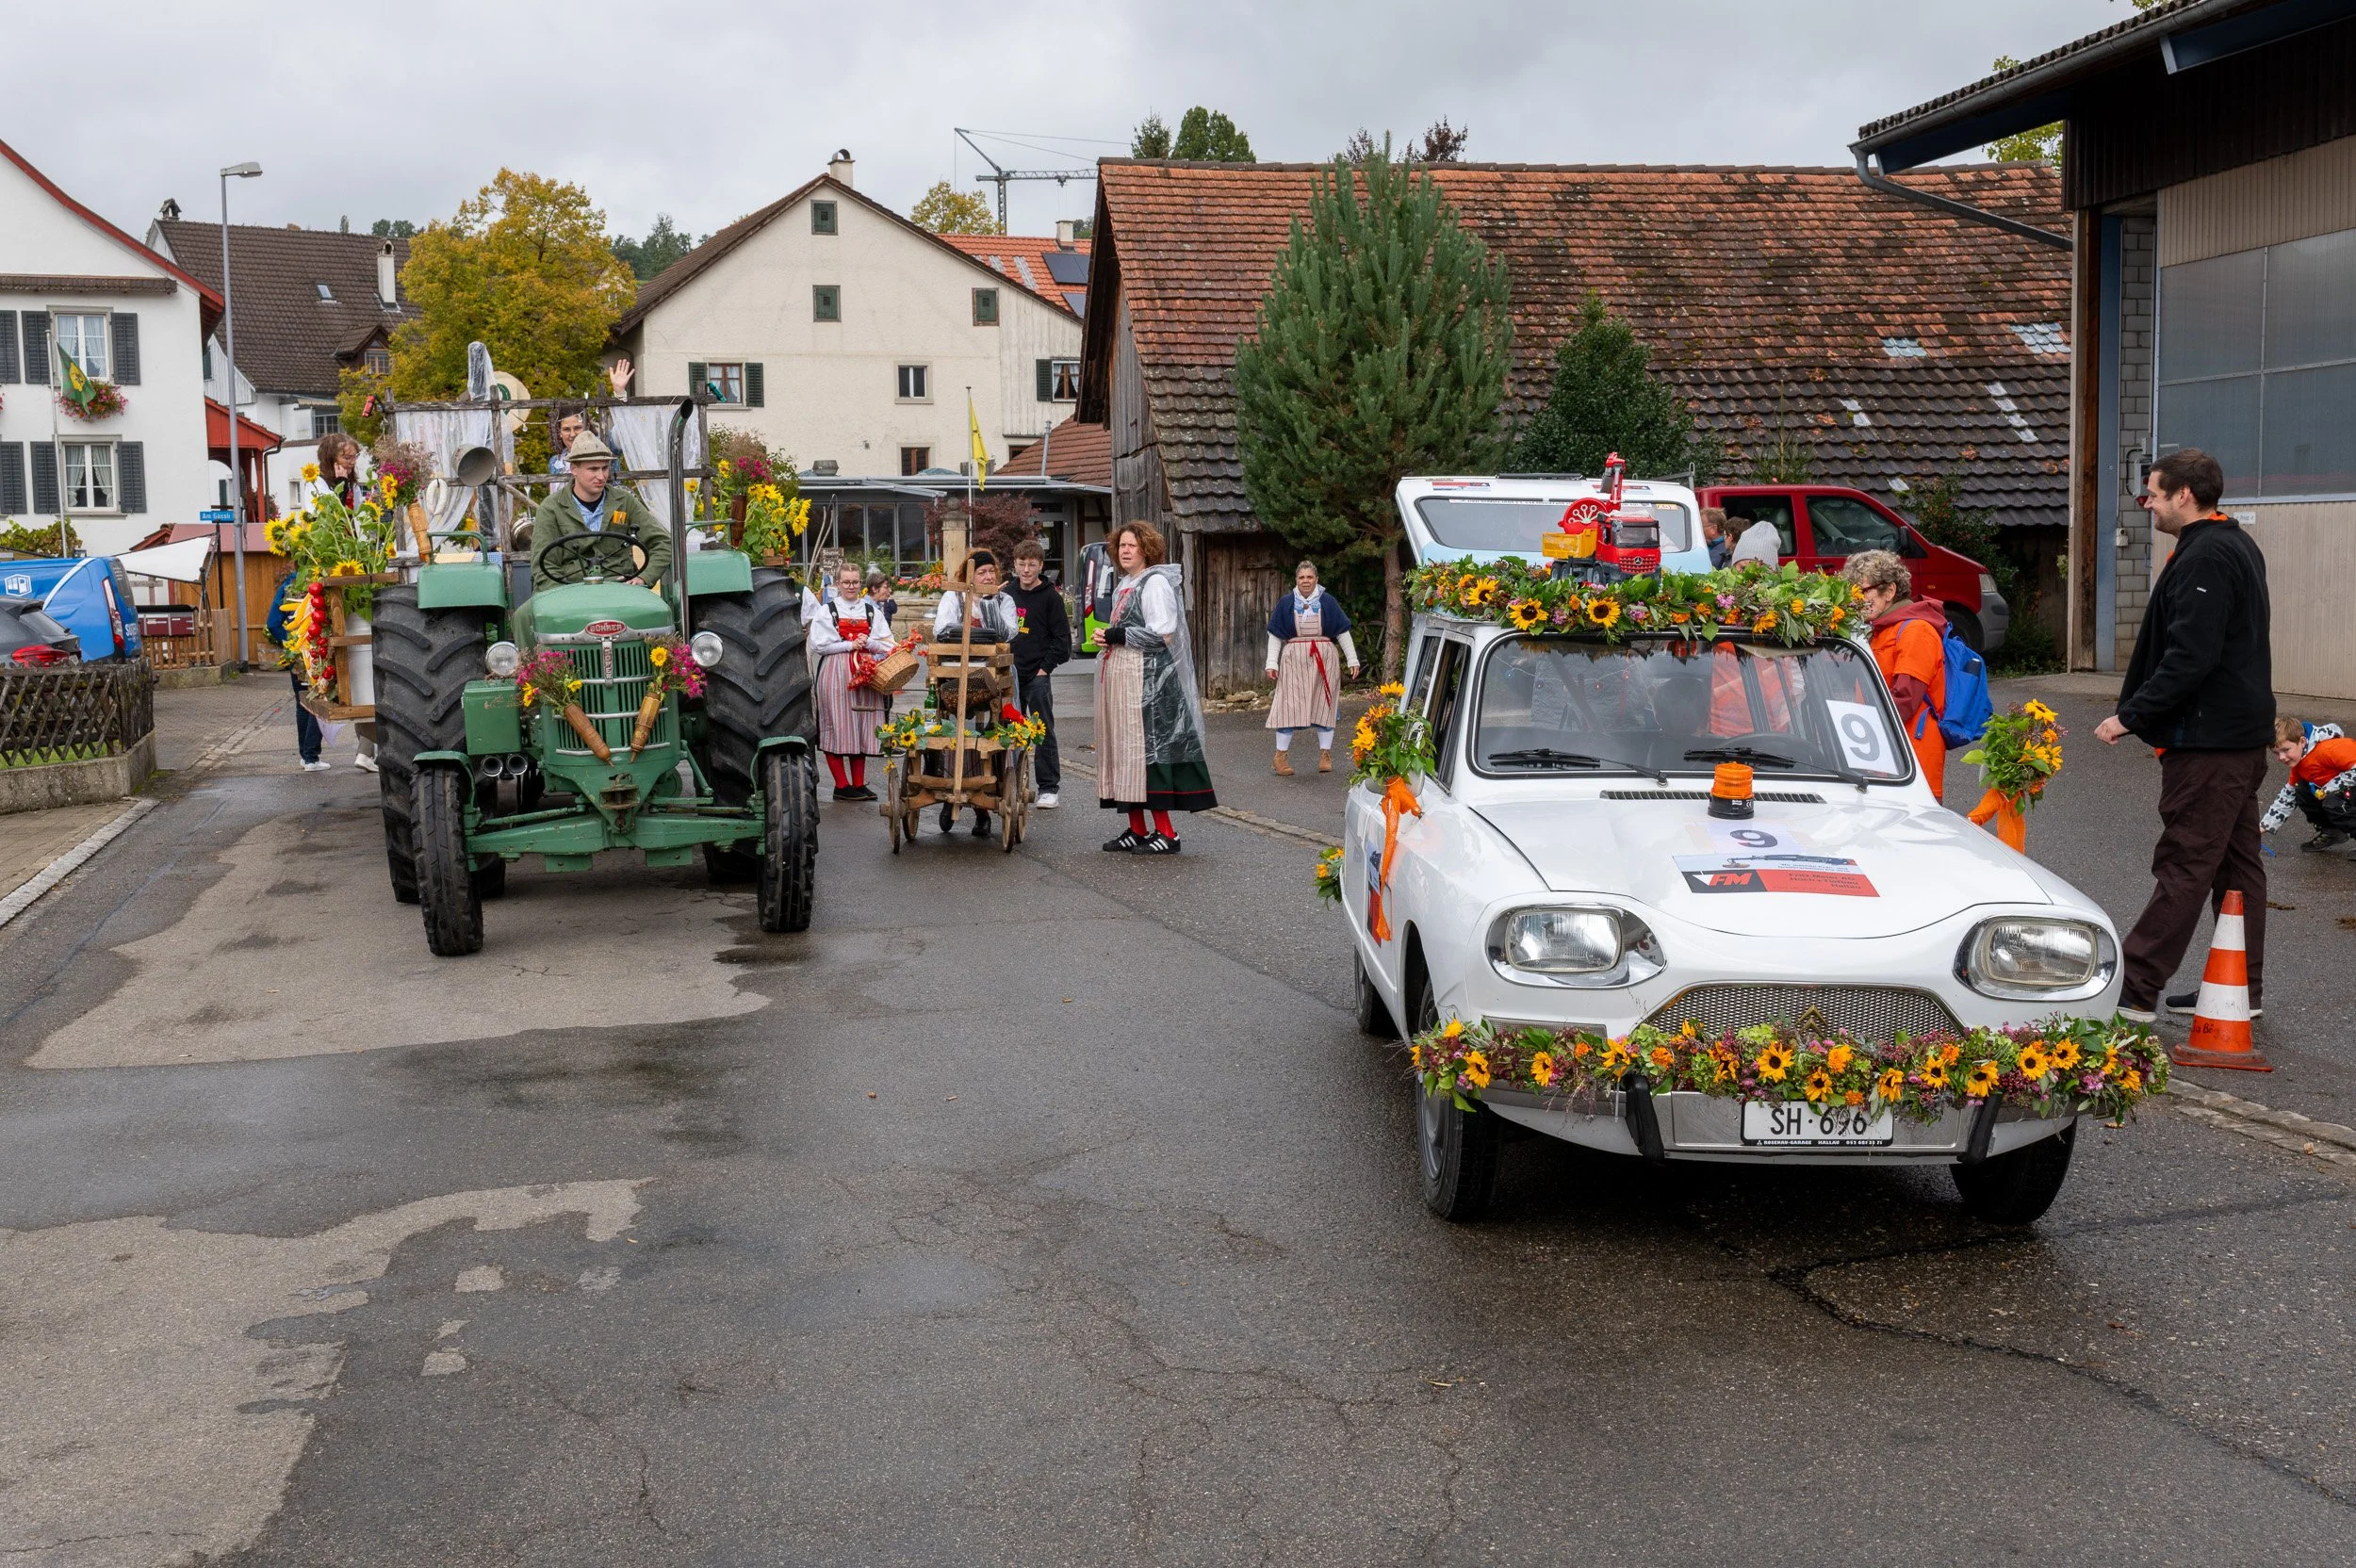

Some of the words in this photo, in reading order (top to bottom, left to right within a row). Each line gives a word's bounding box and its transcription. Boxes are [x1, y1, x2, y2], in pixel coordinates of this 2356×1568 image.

[1841, 712, 1881, 762] 9
[1729, 828, 1778, 848] 9
[1708, 873, 1753, 886] FM
